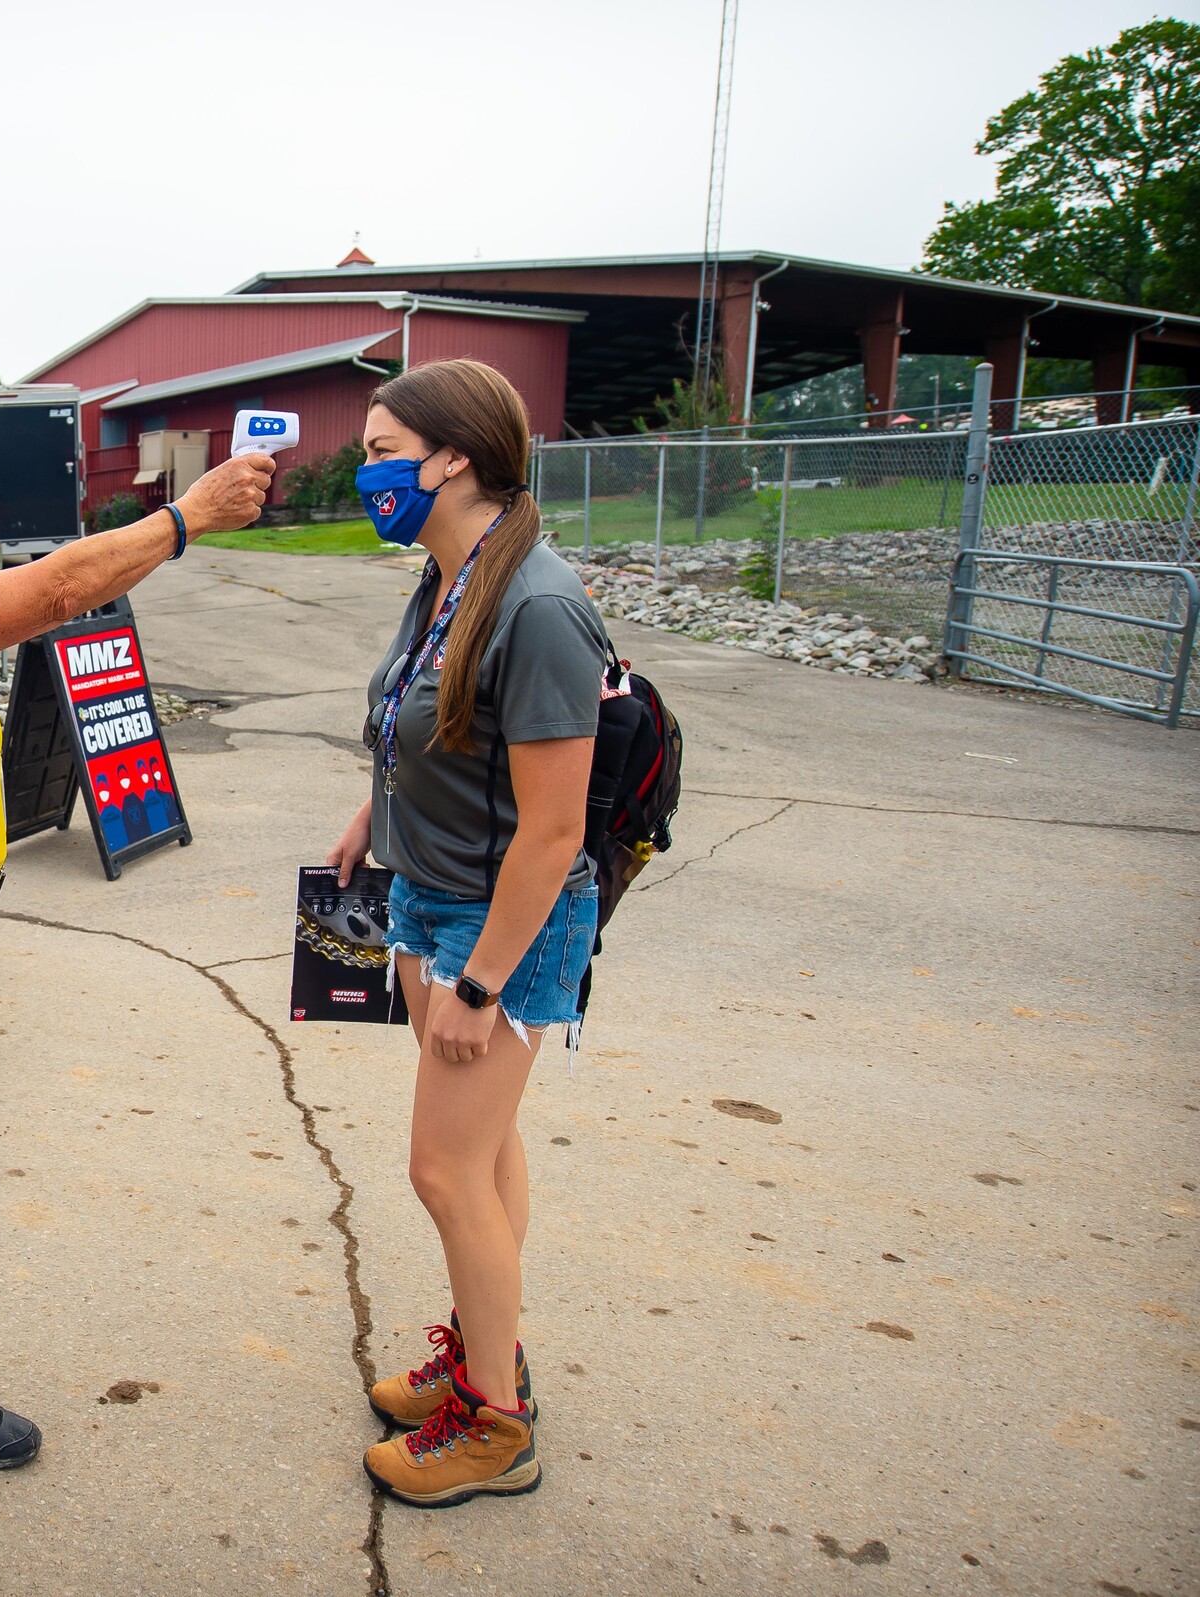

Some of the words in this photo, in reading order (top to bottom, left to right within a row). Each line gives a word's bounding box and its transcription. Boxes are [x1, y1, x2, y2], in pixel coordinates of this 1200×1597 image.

[67, 637, 133, 677] MMZ
[72, 679, 107, 691] MANDATORY
[107, 674, 126, 683] MASK
[125, 671, 140, 679] ZONE
[88, 704, 105, 720] IT'S
[104, 699, 126, 716] COOL
[123, 696, 137, 710] TO
[134, 693, 147, 708] BE
[82, 711, 153, 753] COVERED
[304, 867, 338, 875] RENTHAL
